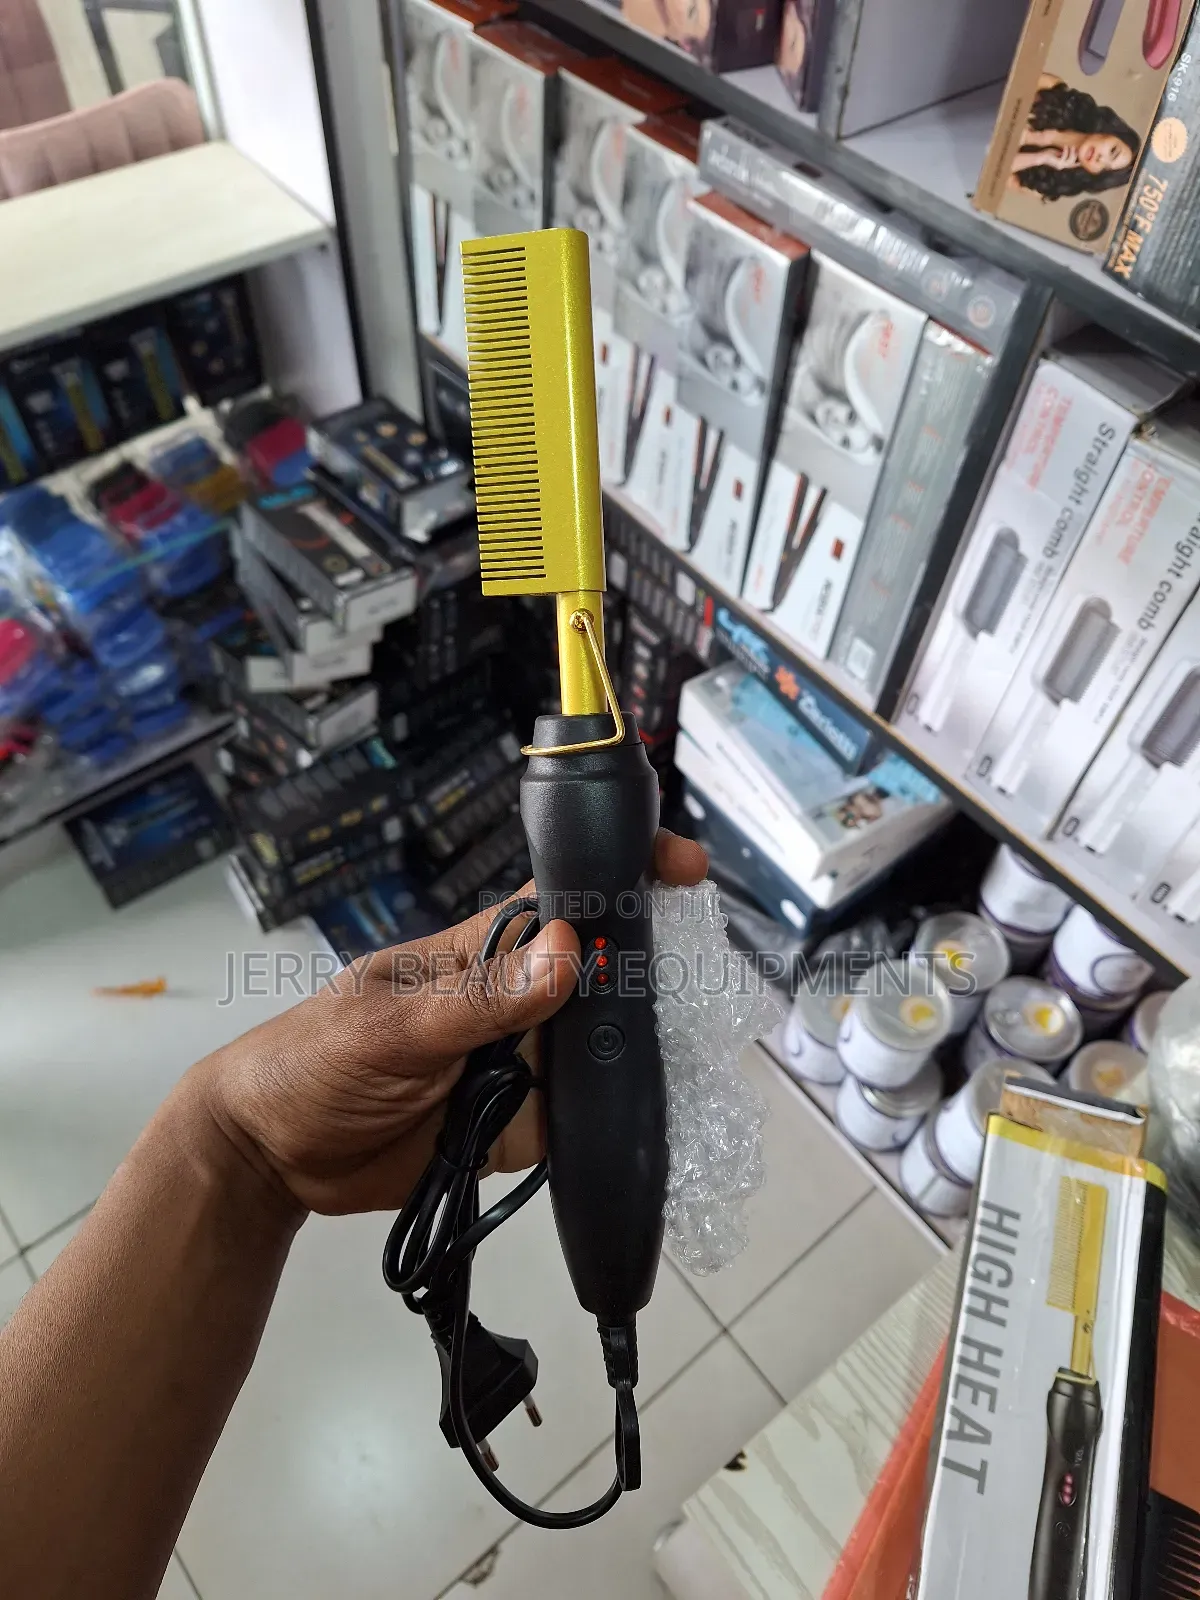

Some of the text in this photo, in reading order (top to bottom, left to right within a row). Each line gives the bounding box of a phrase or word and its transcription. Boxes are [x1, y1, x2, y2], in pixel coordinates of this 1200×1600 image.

[1167, 52, 1192, 103] SK-916
[1113, 229, 1144, 280] MAX
[1042, 421, 1117, 559] Straight comb
[1136, 580, 1173, 631] comb
[941, 1199, 1022, 1496] HIGH HEAT
